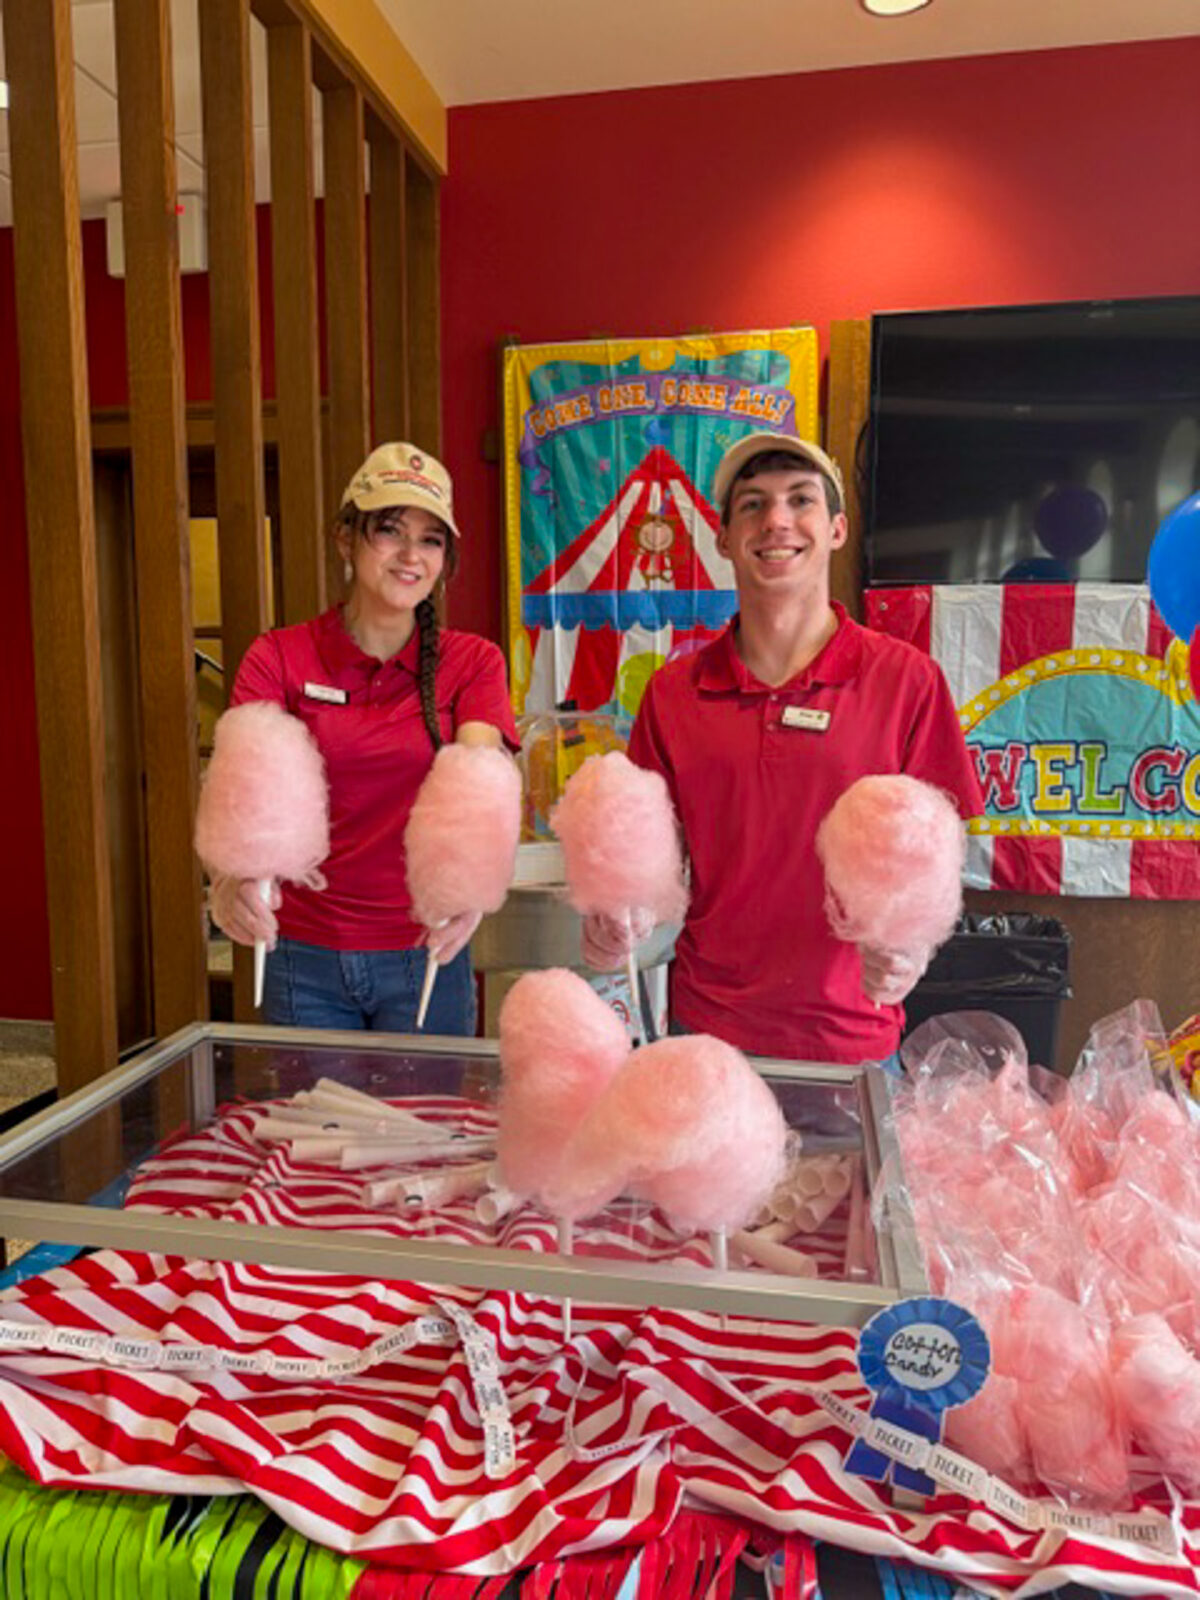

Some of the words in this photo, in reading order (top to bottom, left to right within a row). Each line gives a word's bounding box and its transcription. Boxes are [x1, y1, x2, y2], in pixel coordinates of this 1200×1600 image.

[530, 394, 592, 436] COME
[662, 378, 727, 411] COME
[729, 388, 792, 425] ALL!
[56, 1331, 96, 1349] TICKET
[114, 1341, 150, 1359] TICKET
[166, 1349, 202, 1362] TICKET
[820, 1392, 857, 1424] TICKET
[873, 1426, 914, 1456] TICKET
[933, 1453, 976, 1486] TICKET
[993, 1486, 1027, 1518] TICKET
[1050, 1510, 1093, 1530] TICKET
[1116, 1522, 1160, 1542] TICKET
